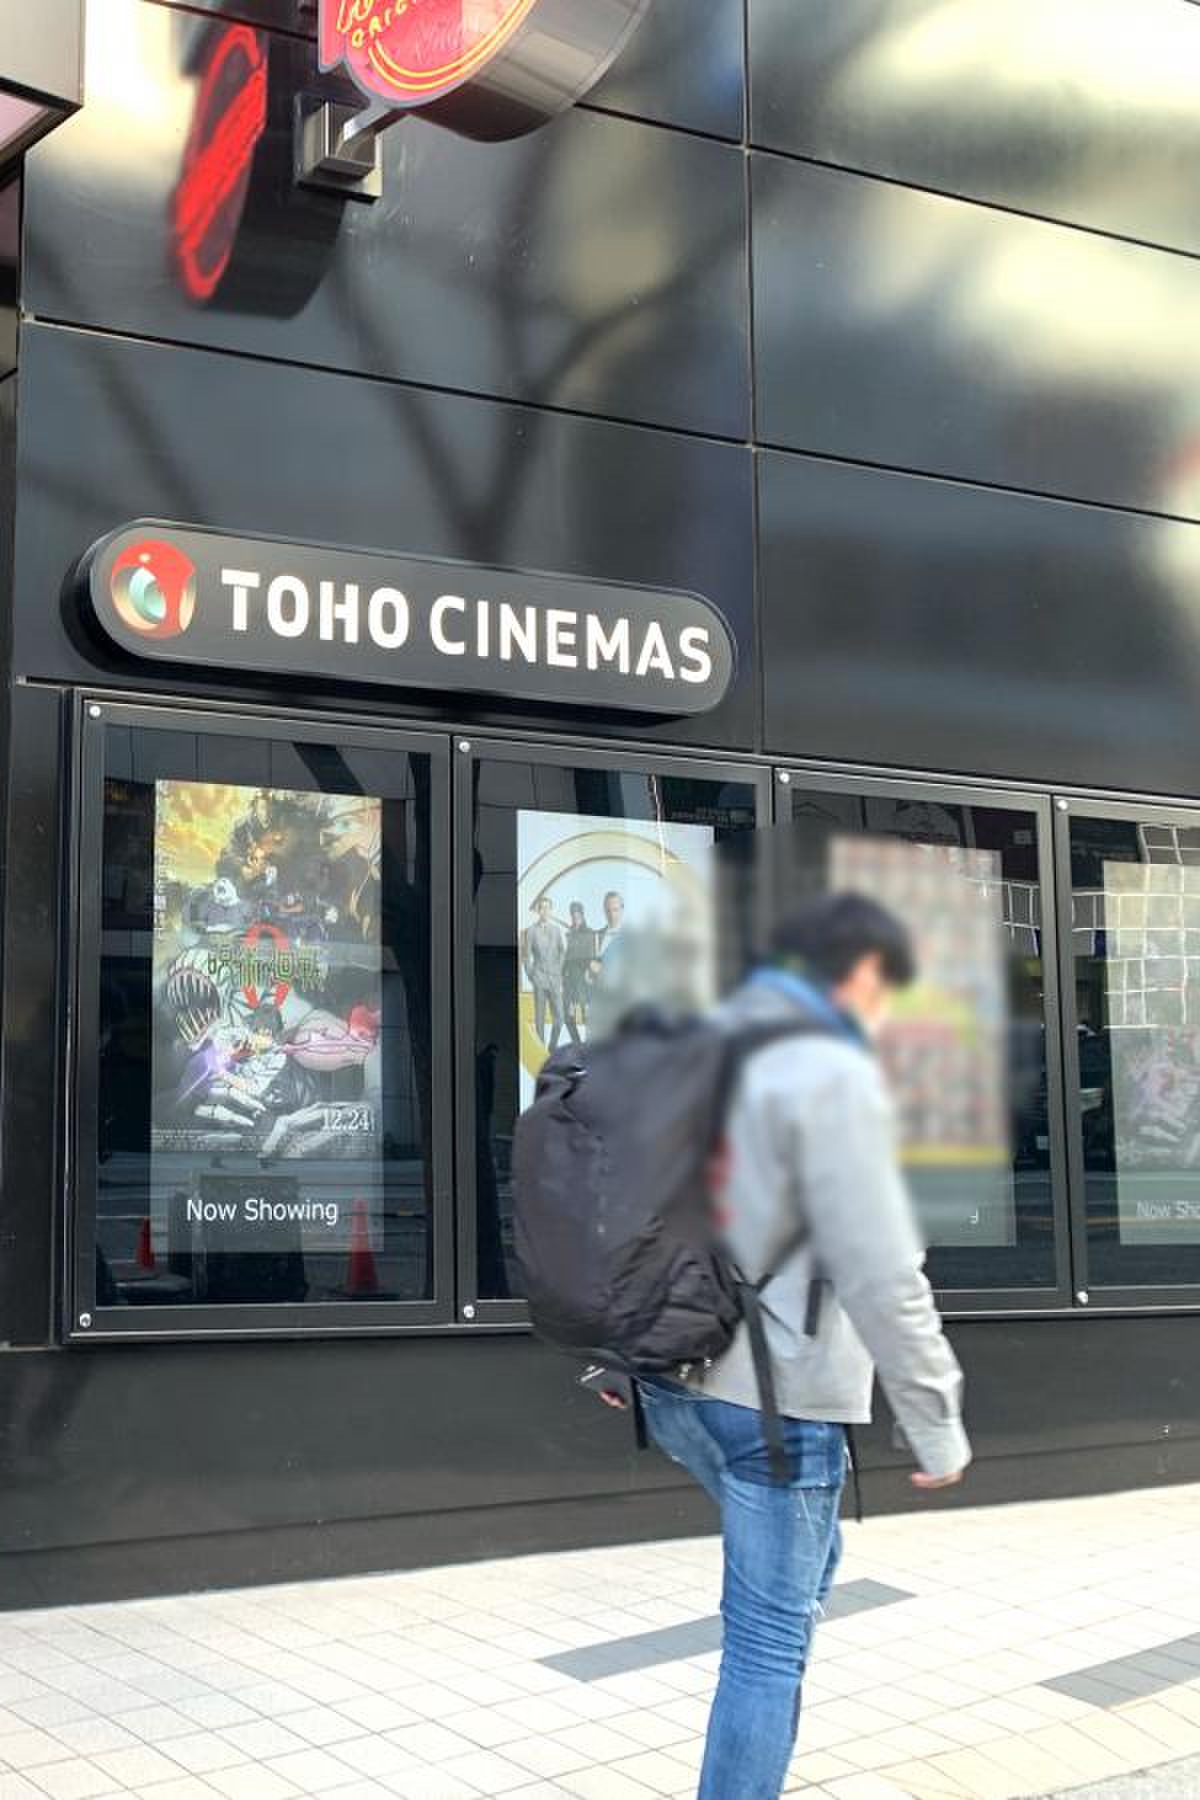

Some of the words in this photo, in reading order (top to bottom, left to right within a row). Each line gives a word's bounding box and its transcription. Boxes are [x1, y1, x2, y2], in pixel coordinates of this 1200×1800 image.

[220, 567, 410, 649] TOHO
[429, 594, 712, 684] CINEMAS
[322, 1107, 370, 1131] 12.24
[186, 1199, 237, 1221] Now
[244, 1199, 339, 1226] Showing
